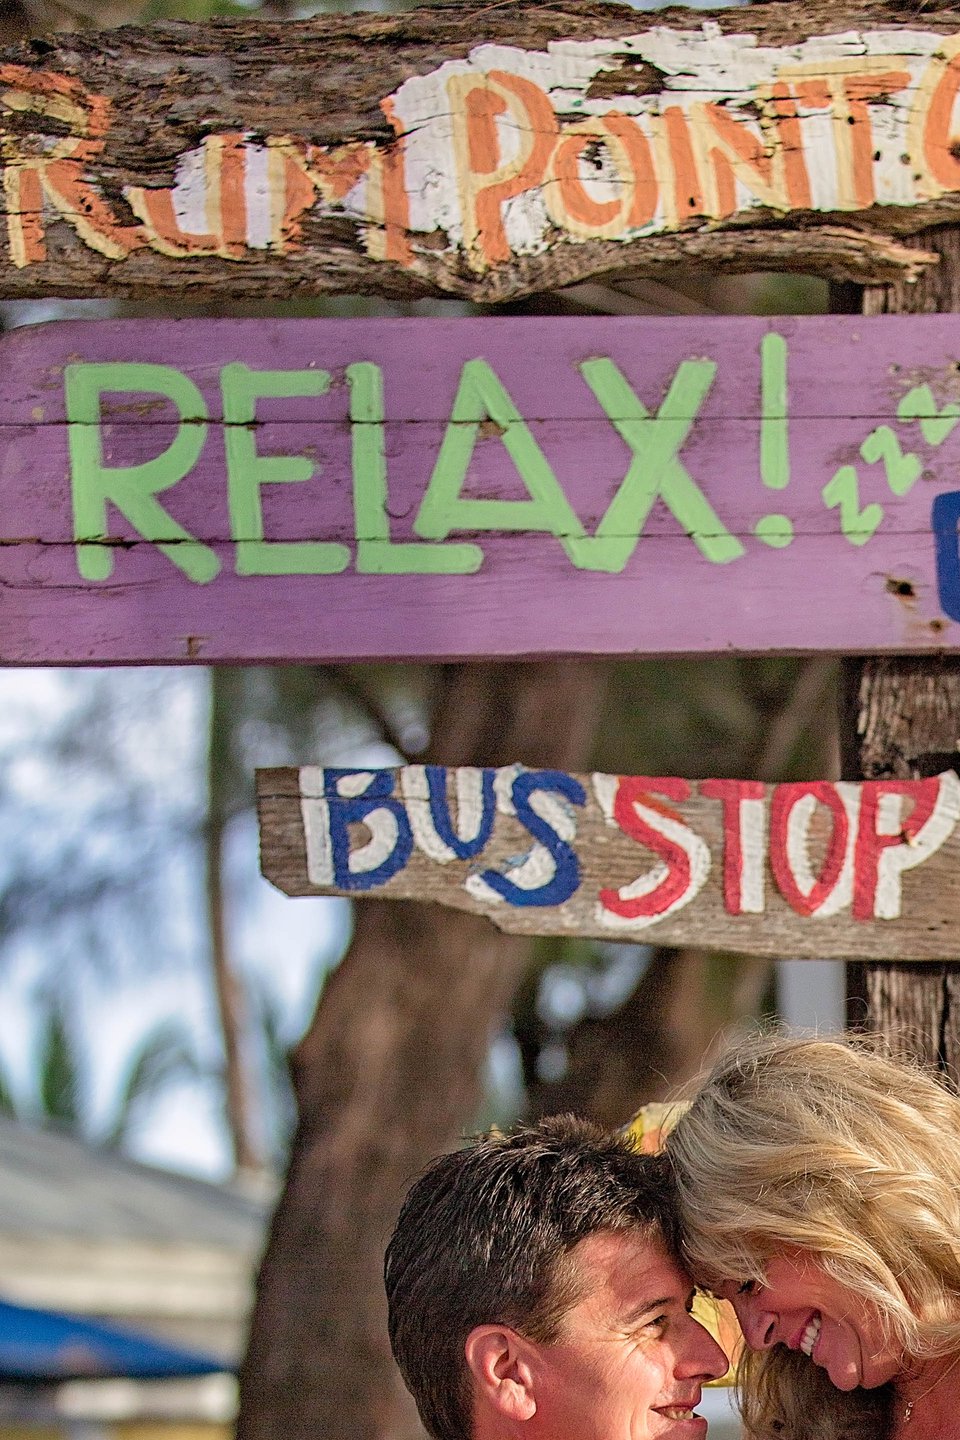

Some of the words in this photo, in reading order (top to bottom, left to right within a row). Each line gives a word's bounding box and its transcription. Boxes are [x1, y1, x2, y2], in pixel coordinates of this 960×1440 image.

[447, 55, 912, 274] POINT
[64, 331, 794, 584] RELAX!
[298, 764, 588, 907] BUS
